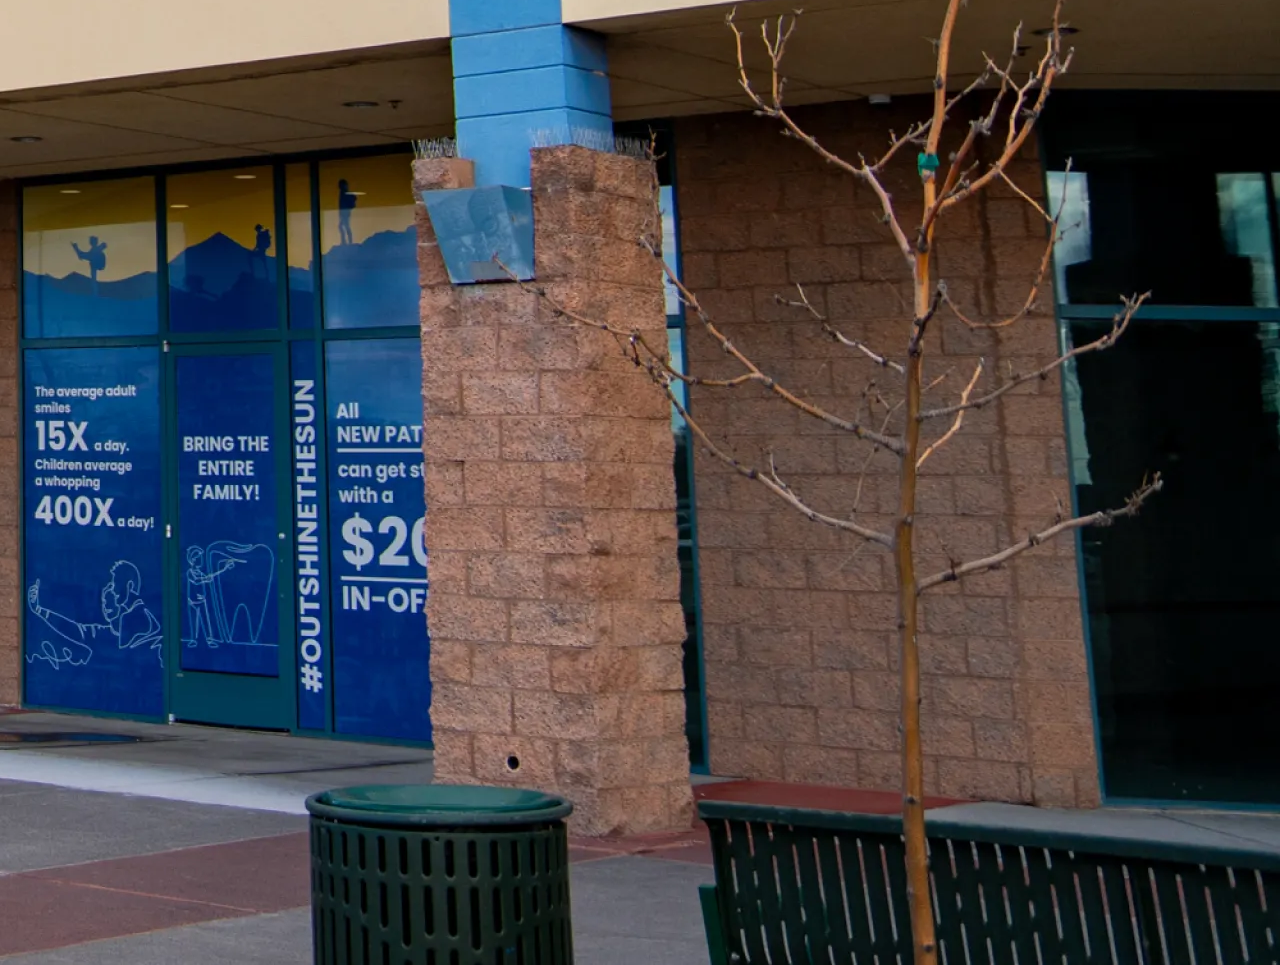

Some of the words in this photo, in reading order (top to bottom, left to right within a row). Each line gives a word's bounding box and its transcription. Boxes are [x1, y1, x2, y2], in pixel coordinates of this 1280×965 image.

[34, 386, 55, 398] The
[56, 387, 103, 401] average
[105, 385, 137, 396] adult
[34, 402, 71, 414] smiles
[336, 402, 359, 419] All
[35, 420, 89, 452] 15X
[94, 442, 102, 452] a
[104, 440, 130, 455] day.
[337, 426, 380, 443] NEW
[384, 425, 423, 443] PAT
[183, 436, 234, 452] BRING
[237, 436, 270, 452] THE
[34, 458, 83, 471] Children
[84, 460, 133, 476] average
[198, 460, 255, 476] ENTIRE
[338, 463, 372, 478] can
[375, 462, 407, 484] get
[35, 477, 43, 486] a
[44, 475, 101, 491] whopping
[193, 484, 260, 501] FAMILY!
[338, 485, 378, 504] with
[381, 490, 394, 504] a
[34, 495, 115, 527] 400X
[117, 518, 125, 528] a
[127, 516, 155, 532] day!
[293, 379, 323, 693] #OUTSHINETHESUN
[342, 586, 428, 613] IN-OF
